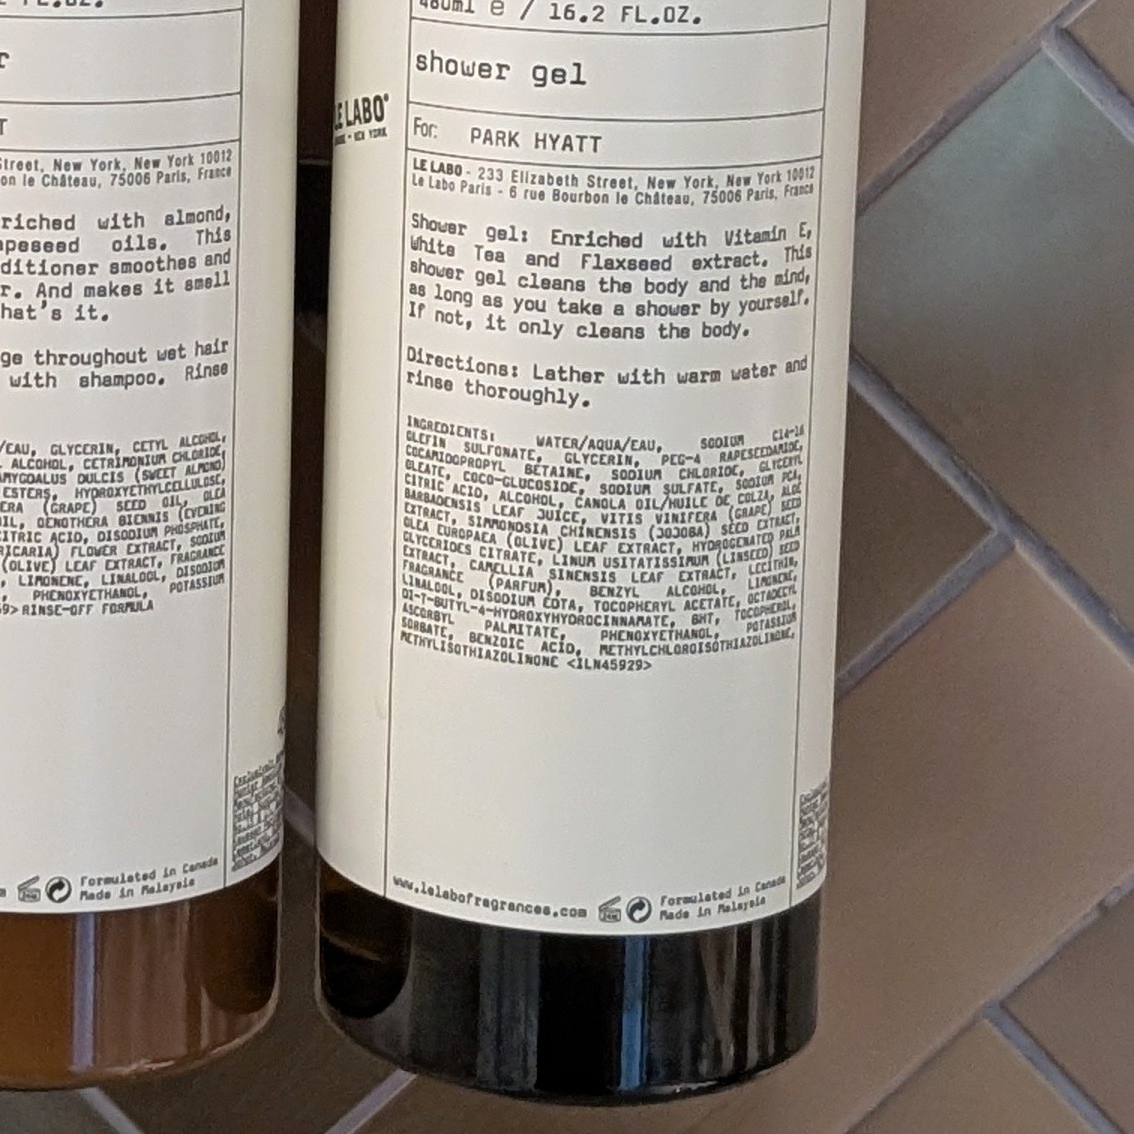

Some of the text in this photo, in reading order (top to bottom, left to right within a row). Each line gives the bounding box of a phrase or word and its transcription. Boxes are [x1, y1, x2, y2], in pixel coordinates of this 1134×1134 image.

[549, 2, 604, 23] 16.2
[621, 5, 701, 25] FL.OZ.
[416, 51, 587, 88] shower gel
[414, 117, 602, 153] For: PARK HYATT
[53, 158, 82, 172] New
[97, 211, 144, 230] with
[165, 204, 230, 227] almond,
[412, 213, 812, 249] Shower gel: Enriched with Vitamin E,
[112, 234, 167, 253] oils.
[196, 227, 231, 249] This
[411, 235, 812, 272] White Tea and Flaxseed extract. This
[109, 254, 197, 275] smoothes
[204, 248, 231, 270] and
[410, 258, 810, 297] shower gel cleans the body and the mind,
[36, 281, 72, 301] And
[84, 280, 143, 298] makes
[154, 277, 174, 295] it
[184, 270, 230, 292] smell
[75, 304, 108, 322] it.
[407, 346, 807, 385] Directions: Lather with warm water and
[407, 370, 590, 409] rinse thoroughly.
